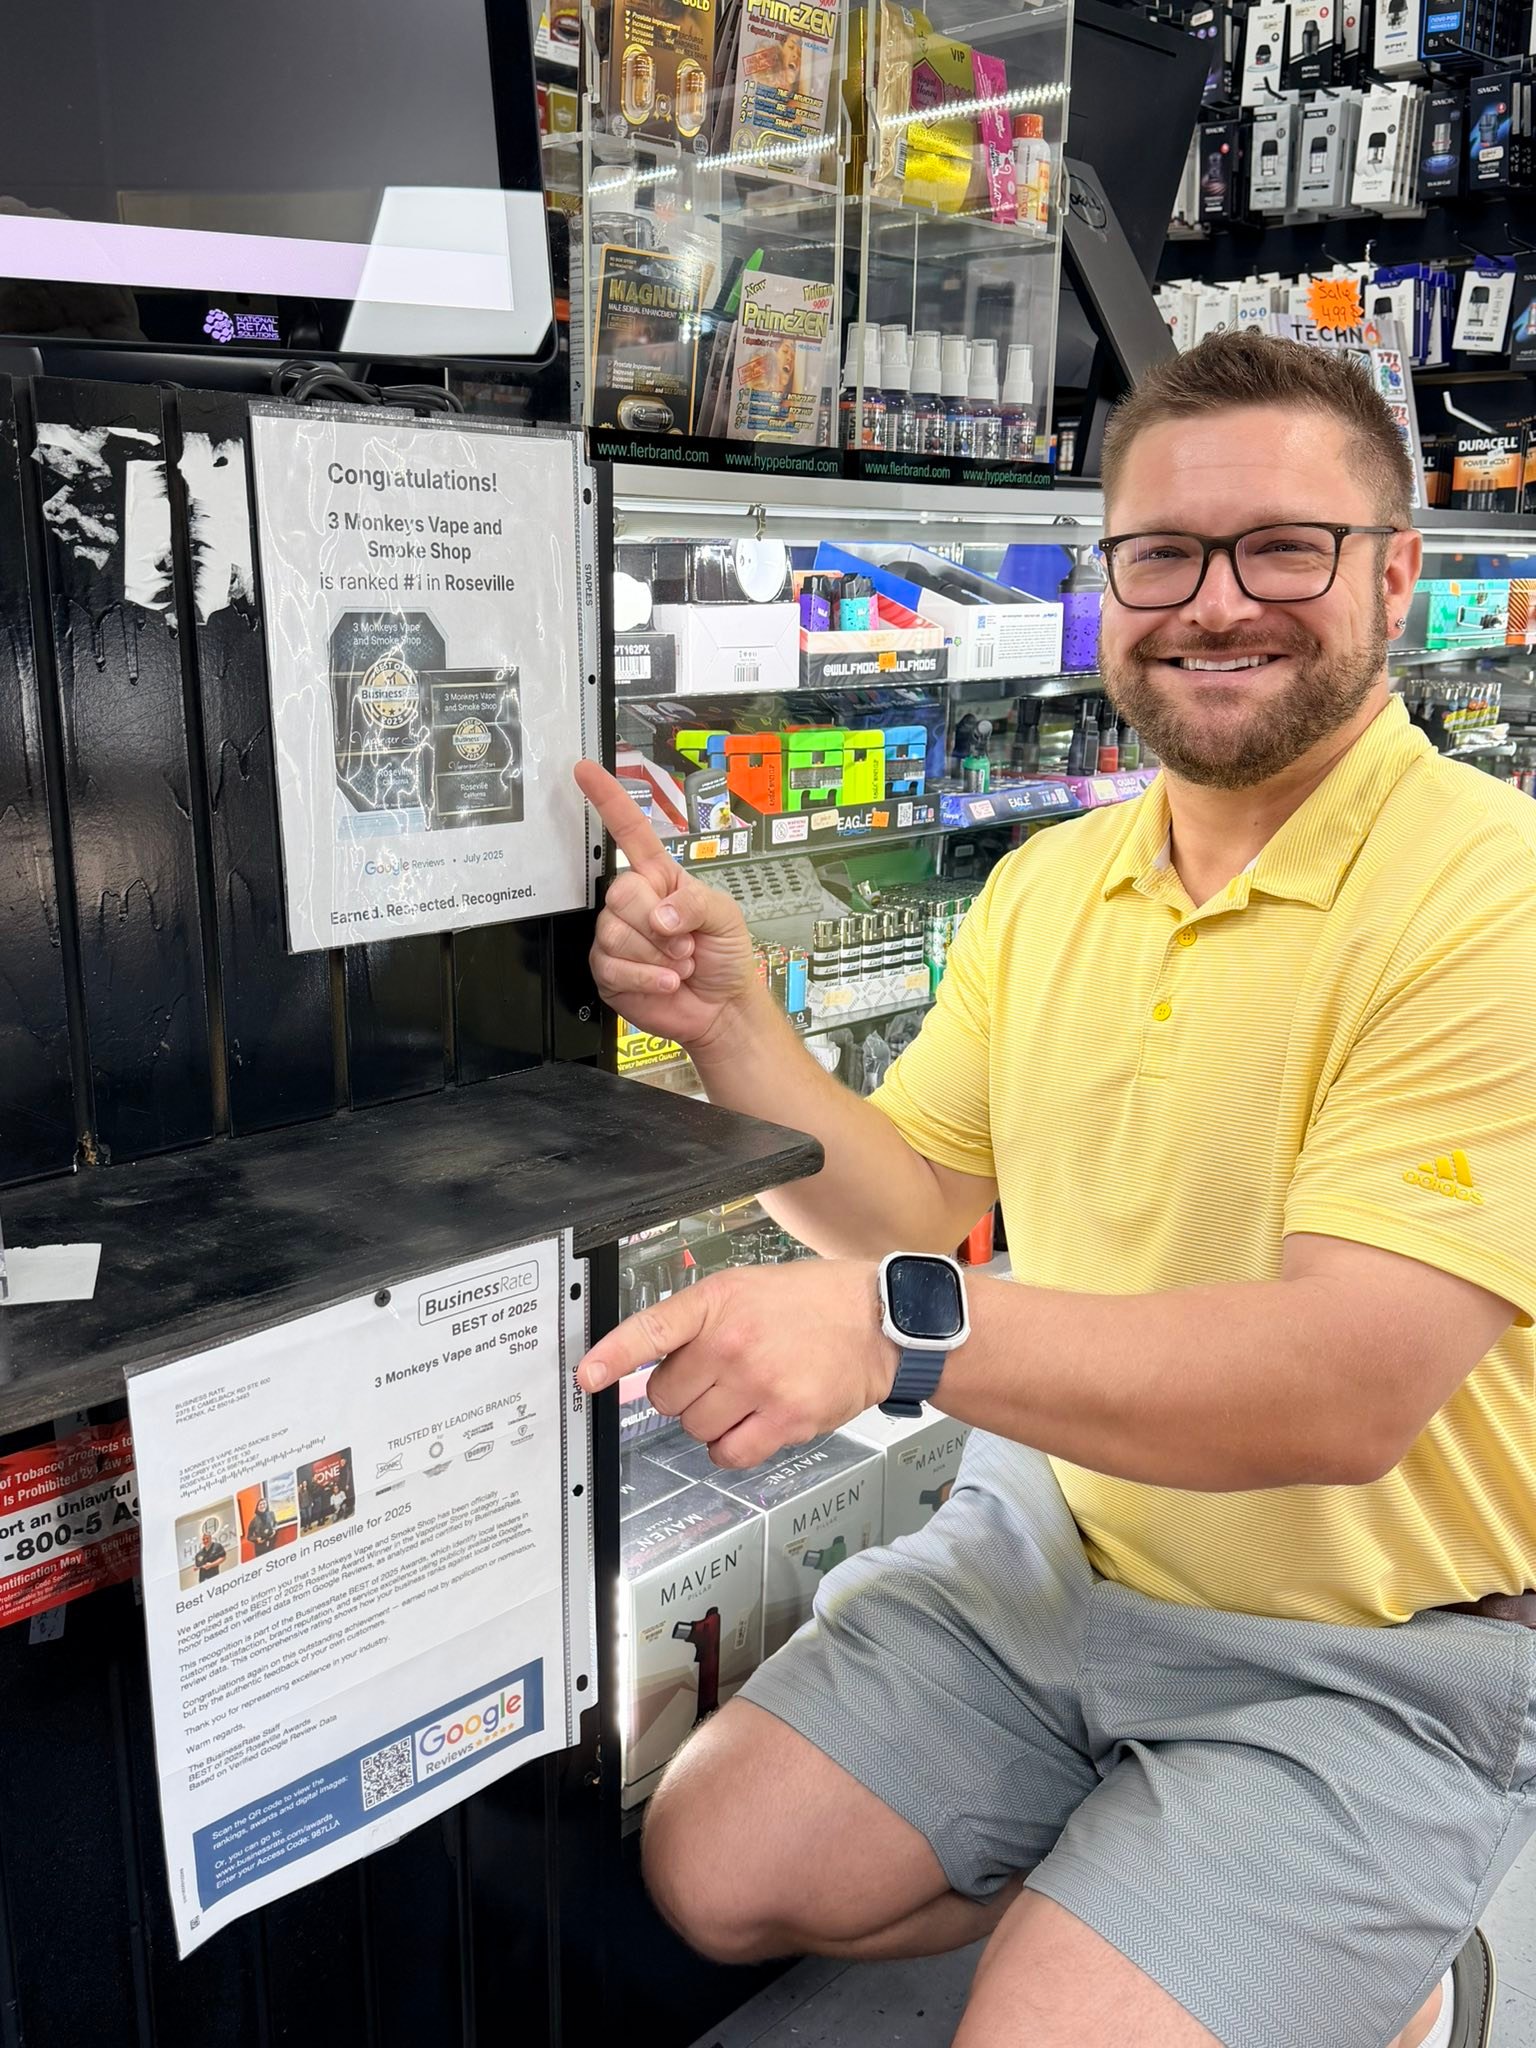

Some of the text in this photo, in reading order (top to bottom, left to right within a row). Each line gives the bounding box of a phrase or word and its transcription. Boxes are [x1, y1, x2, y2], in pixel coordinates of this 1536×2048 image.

[950, 48, 965, 63] VIP
[1432, 98, 1455, 107] SMOK
[1477, 85, 1501, 95] SMOK
[745, 279, 766, 298] New
[236, 316, 278, 324] NATIONAL
[622, 305, 641, 314] SEXUAL
[641, 307, 677, 318] ENHANCEMENT
[237, 322, 279, 333] RETAIL
[238, 331, 280, 339] SOLUTIONS
[1458, 436, 1517, 452] DURACELL
[1464, 459, 1488, 467] POWER
[327, 462, 498, 493] Congratulations!
[328, 511, 502, 538] 3 Monkeys Vape and
[368, 540, 471, 563] Smoke Shop
[320, 572, 515, 592] is ranked #1 in Roseville
[584, 563, 594, 606] STAPLES
[353, 622, 421, 634] 3 Monkeys Vape
[353, 636, 369, 645] and
[371, 636, 399, 646] Smoke
[444, 692, 497, 702] 3 Monkeys Vape
[444, 702, 497, 712] and Smoke Shop
[381, 716, 404, 726] 2025
[460, 782, 489, 792] Roseville
[463, 791, 487, 799] California
[364, 850, 504, 877] Google Reviews July 2025
[330, 907, 384, 925] Earned.
[461, 884, 537, 908] Recognized.
[1403, 1169, 1484, 1205] adidas
[425, 1273, 532, 1316] BusinessRate
[452, 1299, 538, 1336] BEST of 2025
[375, 1325, 538, 1388] 3 Monkeys Vape and Smoke
[509, 1338, 539, 1355] Shop
[387, 1392, 522, 1450] TRUSTED BY LEADING BRANDS
[0, 1435, 133, 1490] of Tobacco Products to
[916, 1435, 965, 1472] MAVEN
[768, 1451, 828, 1485] MAVEN
[4, 1493, 15, 1506] Is
[17, 1470, 78, 1502] Prohibited
[80, 1464, 94, 1479] by
[30, 1513, 51, 1529] an
[56, 1480, 131, 1517] Unlawful
[792, 1485, 860, 1535] MAVEN
[636, 1513, 703, 1549] MAVEN
[816, 1516, 838, 1531] PILLAR
[60, 1553, 82, 1570] May
[84, 1549, 98, 1560] Be
[175, 1502, 412, 1614] Best Vaporizer Store in Roseville for 2025
[35, 1578, 52, 1590] Code
[660, 1550, 738, 1606] MAVEN
[688, 1584, 712, 1601] PILLAR
[2, 1604, 24, 1617] covered
[419, 1692, 522, 1756] Google
[425, 1742, 474, 1774] Reviews
[212, 1778, 324, 1840] Scan the QR code to view the
[213, 1775, 348, 1850] rankings, awards and digital images:
[214, 1828, 282, 1869] Or, you can go to:
[215, 1813, 333, 1879] www.businessrate.com/awards
[216, 1873, 237, 1889] Enter
[238, 1862, 256, 1878] your
[256, 1848, 286, 1867] Access
[286, 1835, 310, 1851] Code:
